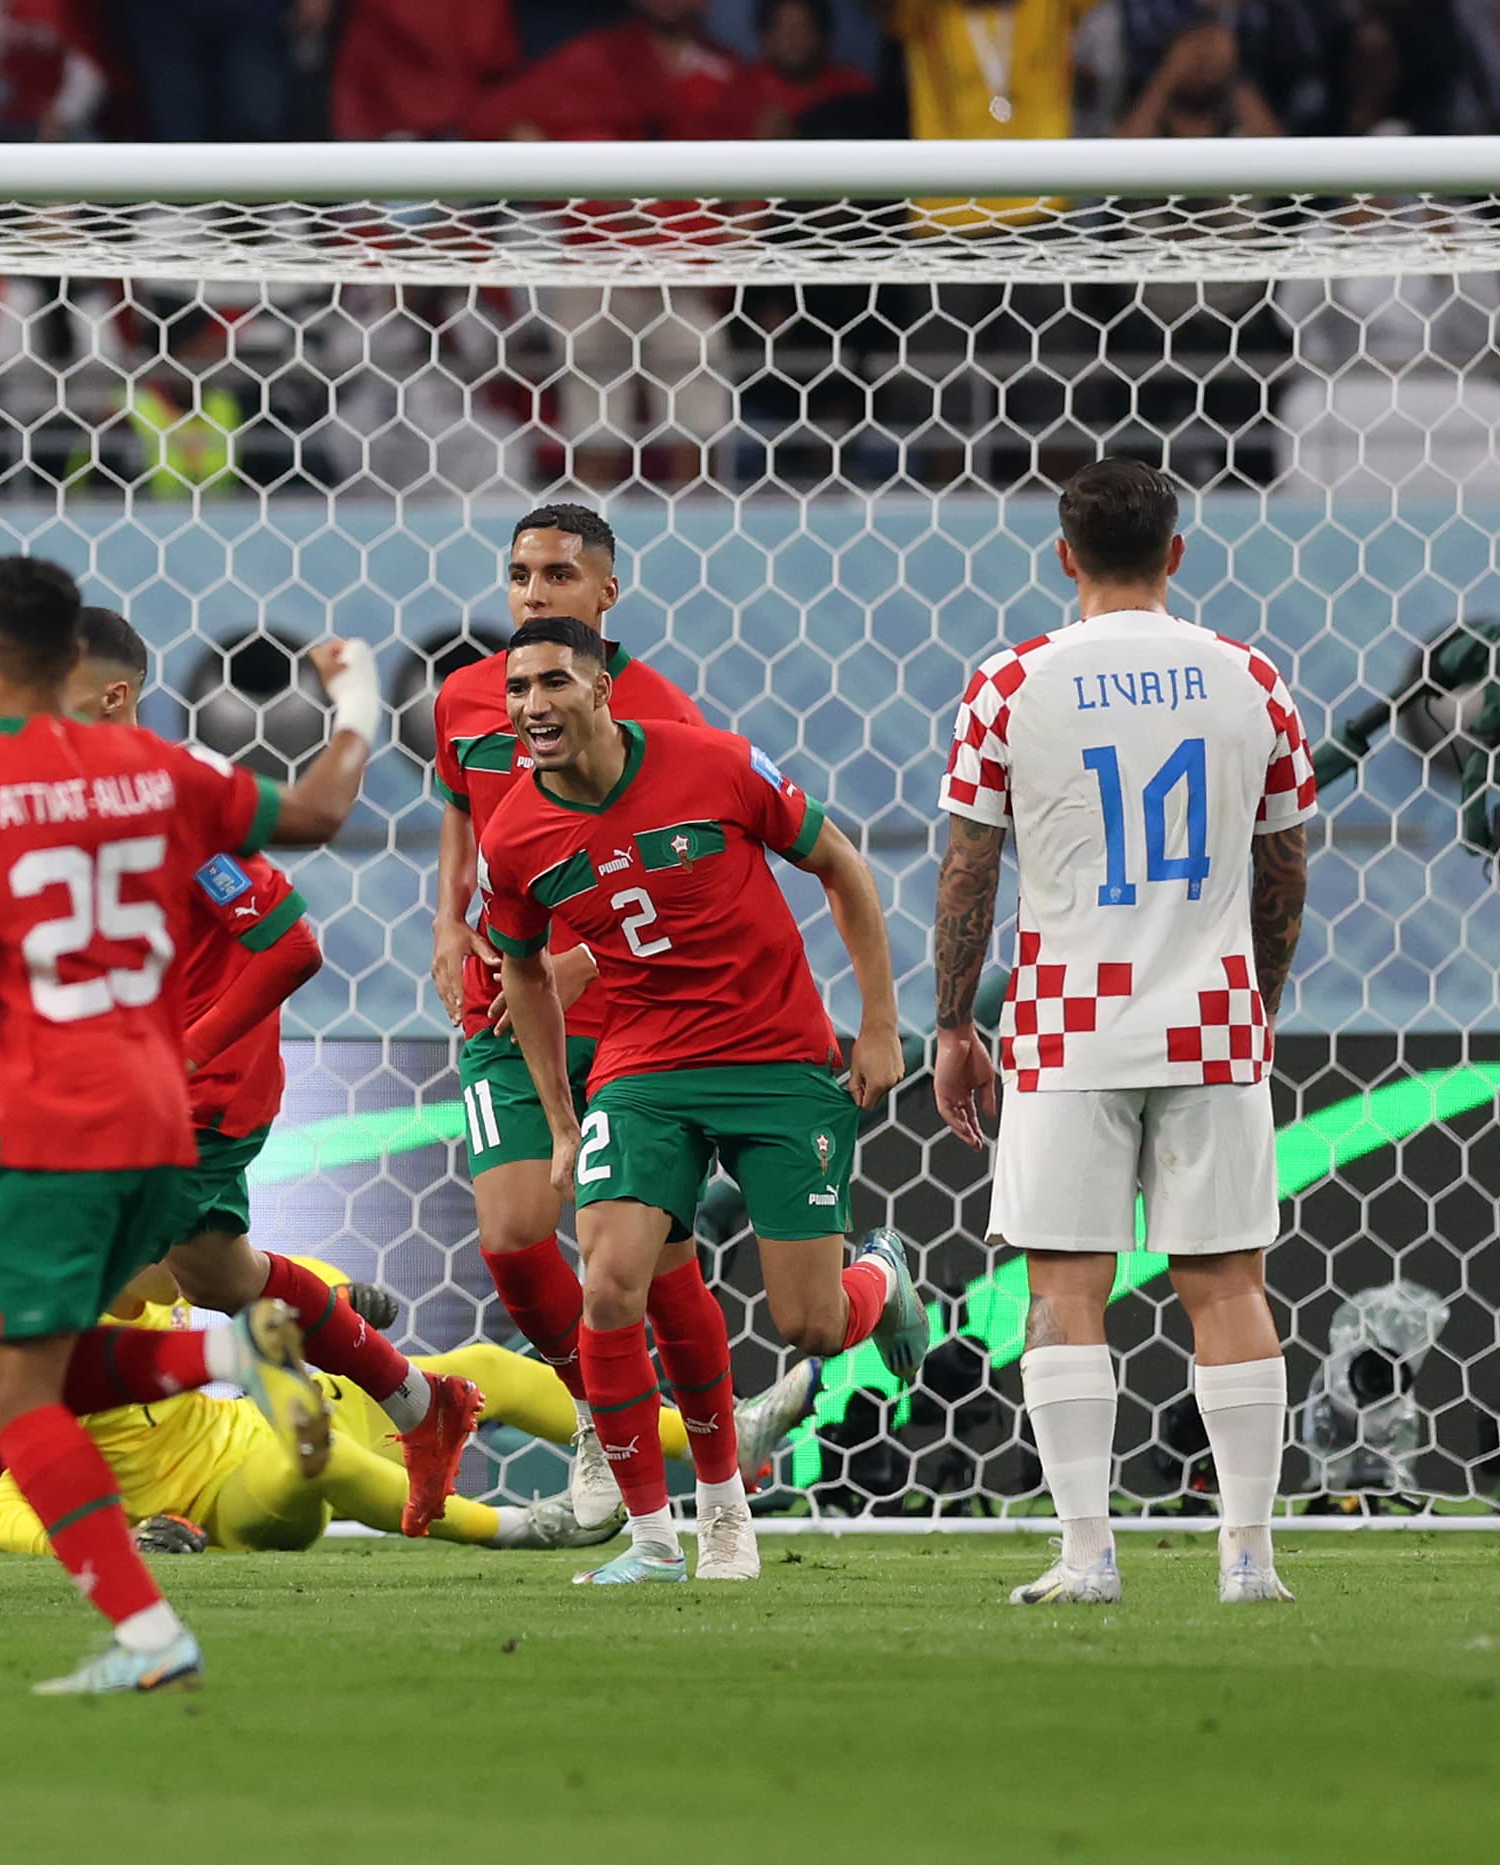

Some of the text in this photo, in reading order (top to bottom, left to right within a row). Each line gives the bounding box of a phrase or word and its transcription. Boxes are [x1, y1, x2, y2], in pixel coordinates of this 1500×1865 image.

[1074, 666, 1207, 710] LIVAJA
[1082, 738, 1211, 907] 14
[8, 834, 177, 1023] 25
[610, 886, 672, 957] 2
[464, 1079, 501, 1156] 11
[577, 1110, 611, 1185] 2
